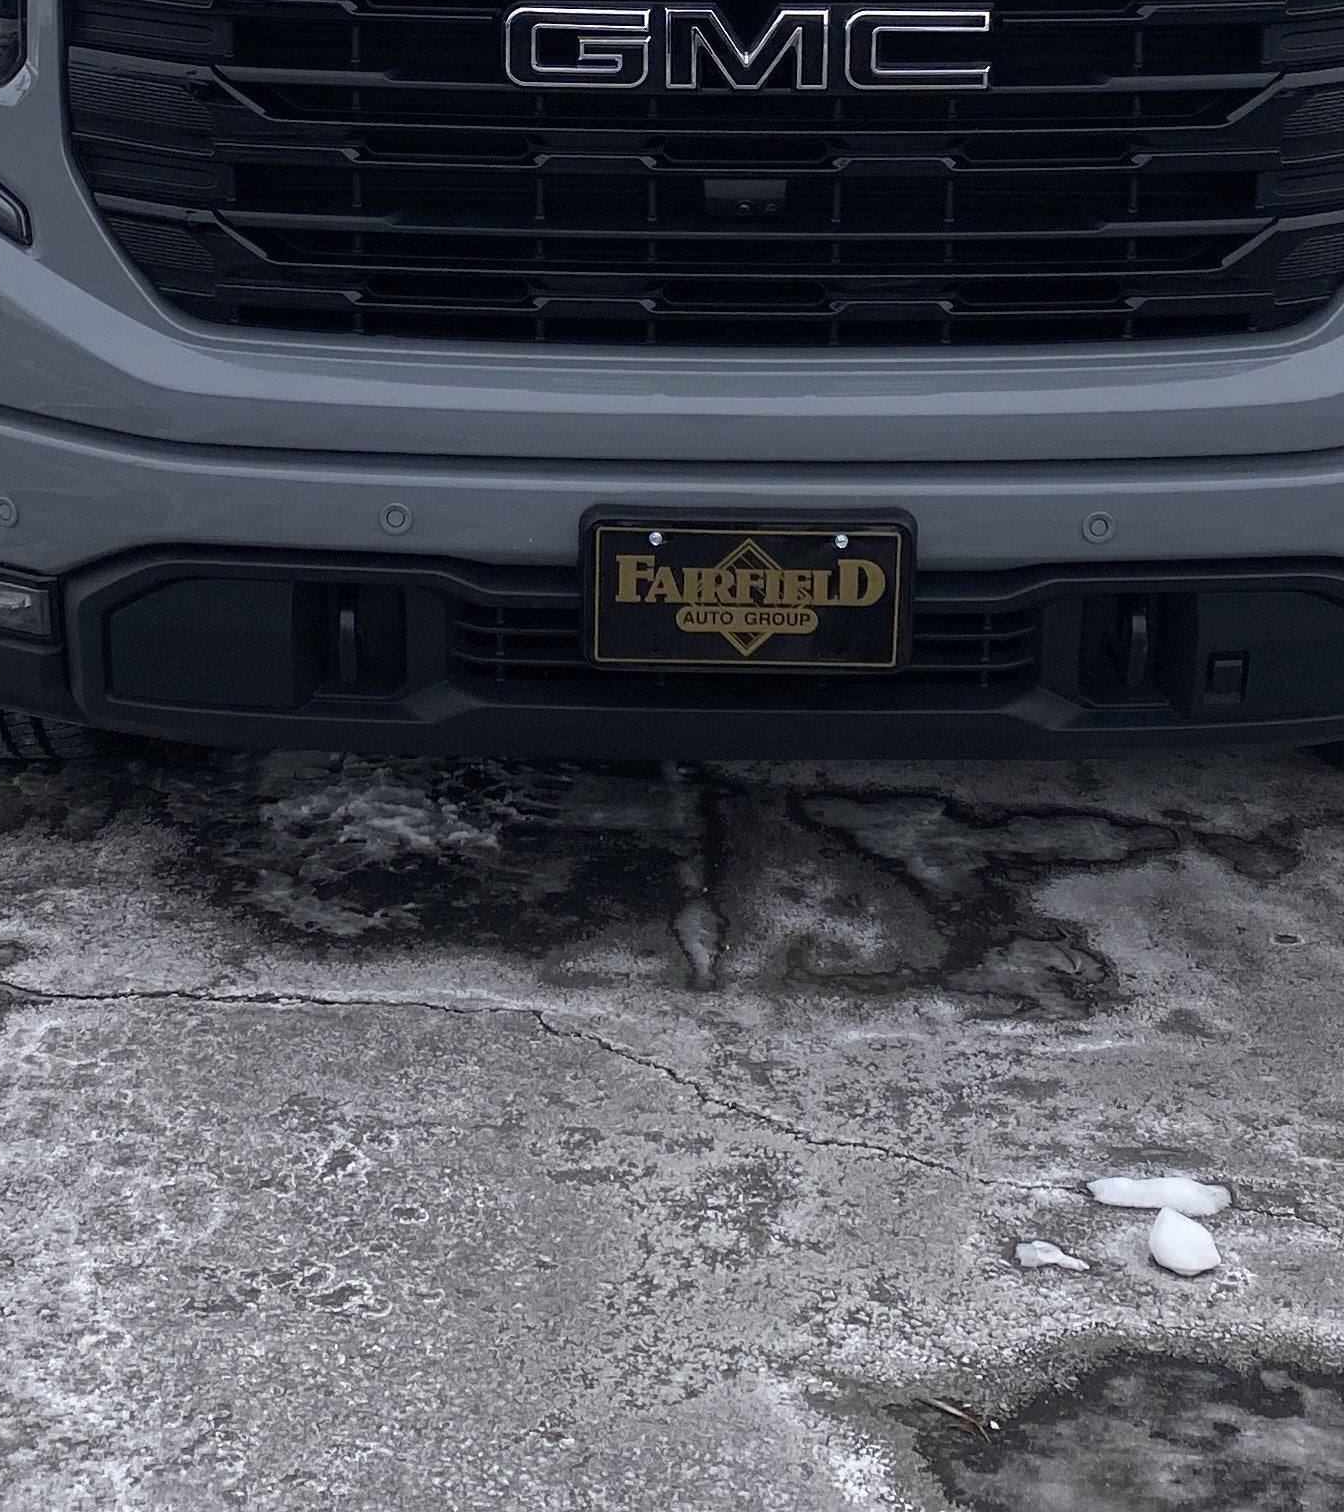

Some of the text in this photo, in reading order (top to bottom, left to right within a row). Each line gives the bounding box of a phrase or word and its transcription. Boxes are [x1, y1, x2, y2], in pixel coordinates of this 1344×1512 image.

[505, 6, 991, 89] GMC
[615, 554, 886, 607] FAIRFIELD
[682, 610, 811, 627] AUTO GROUP
